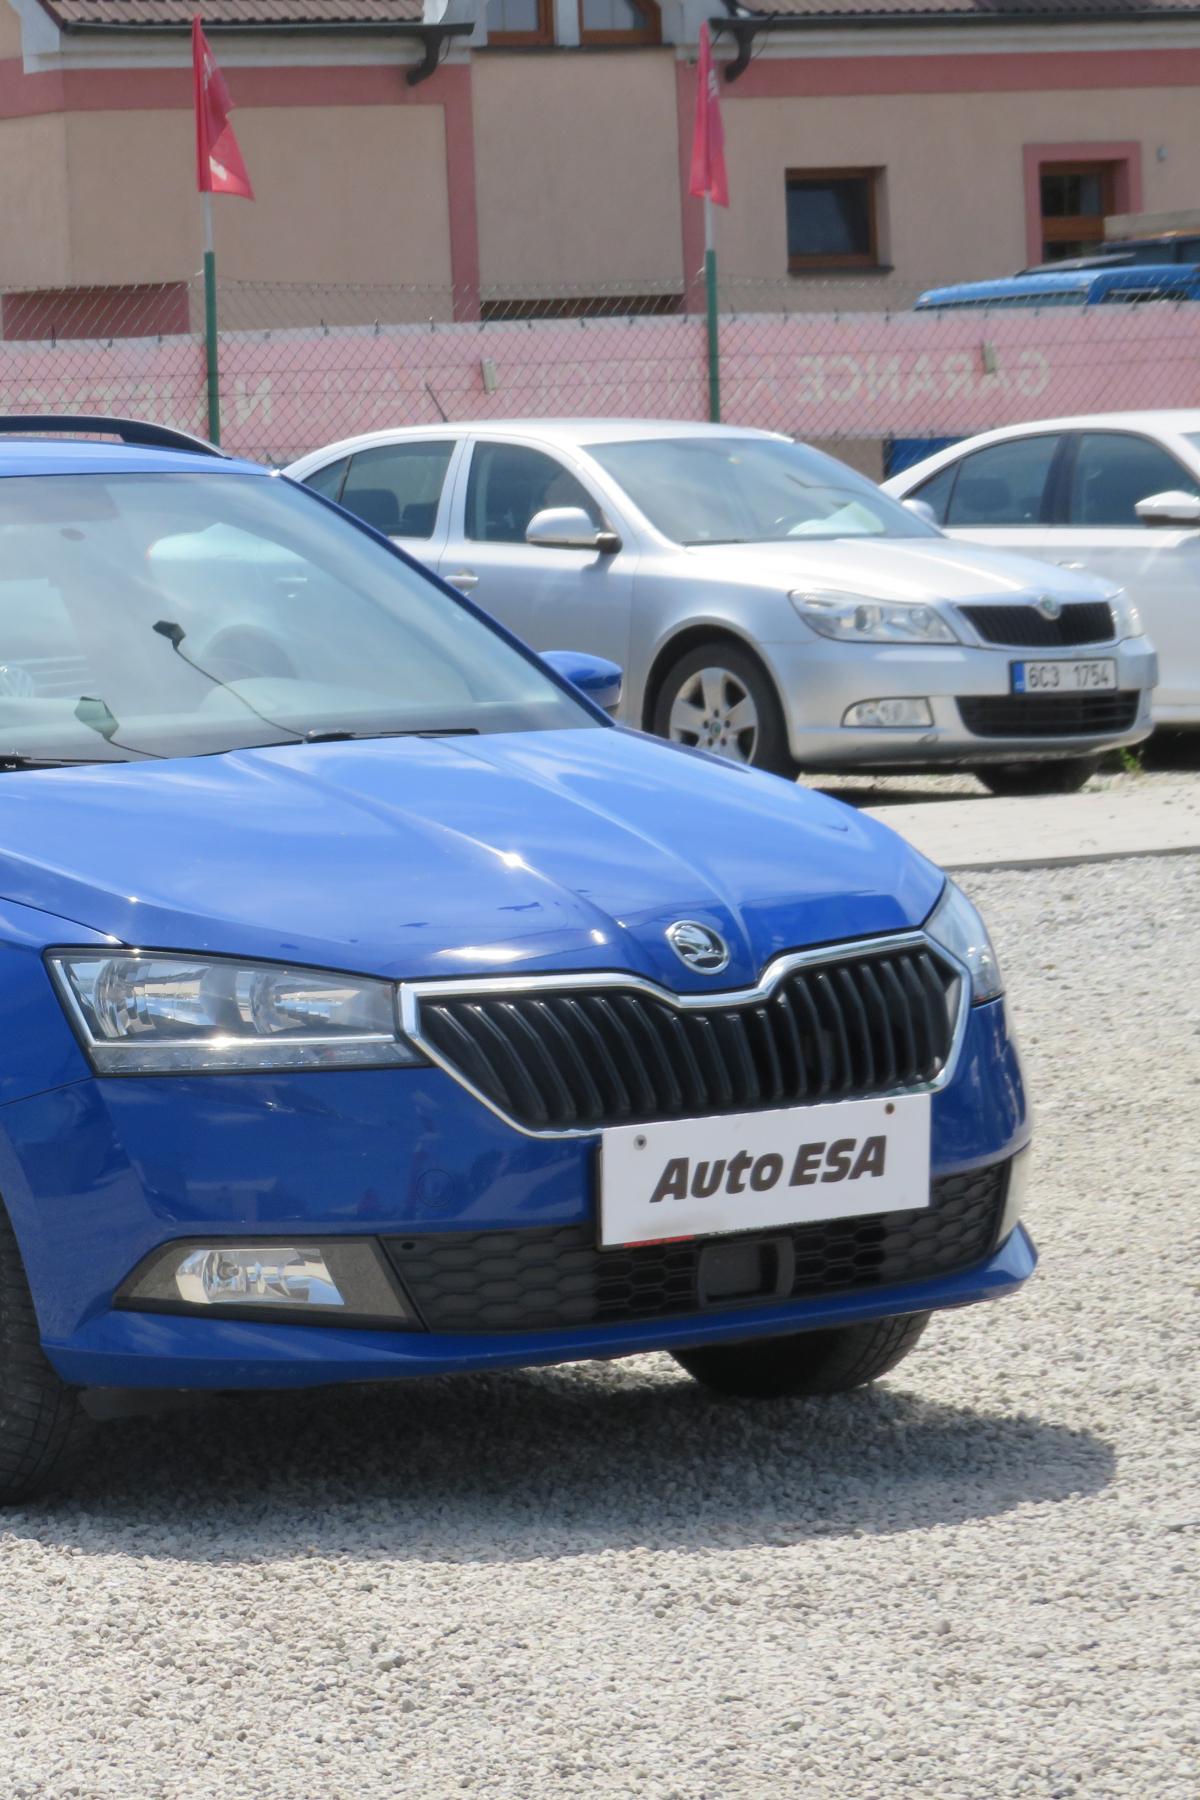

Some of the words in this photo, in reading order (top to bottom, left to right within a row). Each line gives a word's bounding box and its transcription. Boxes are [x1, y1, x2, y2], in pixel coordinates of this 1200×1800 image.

[1029, 665, 1060, 688] 6C3
[1073, 663, 1109, 687] 1754
[650, 1150, 784, 1203] Auto
[789, 1135, 887, 1187] ESA
